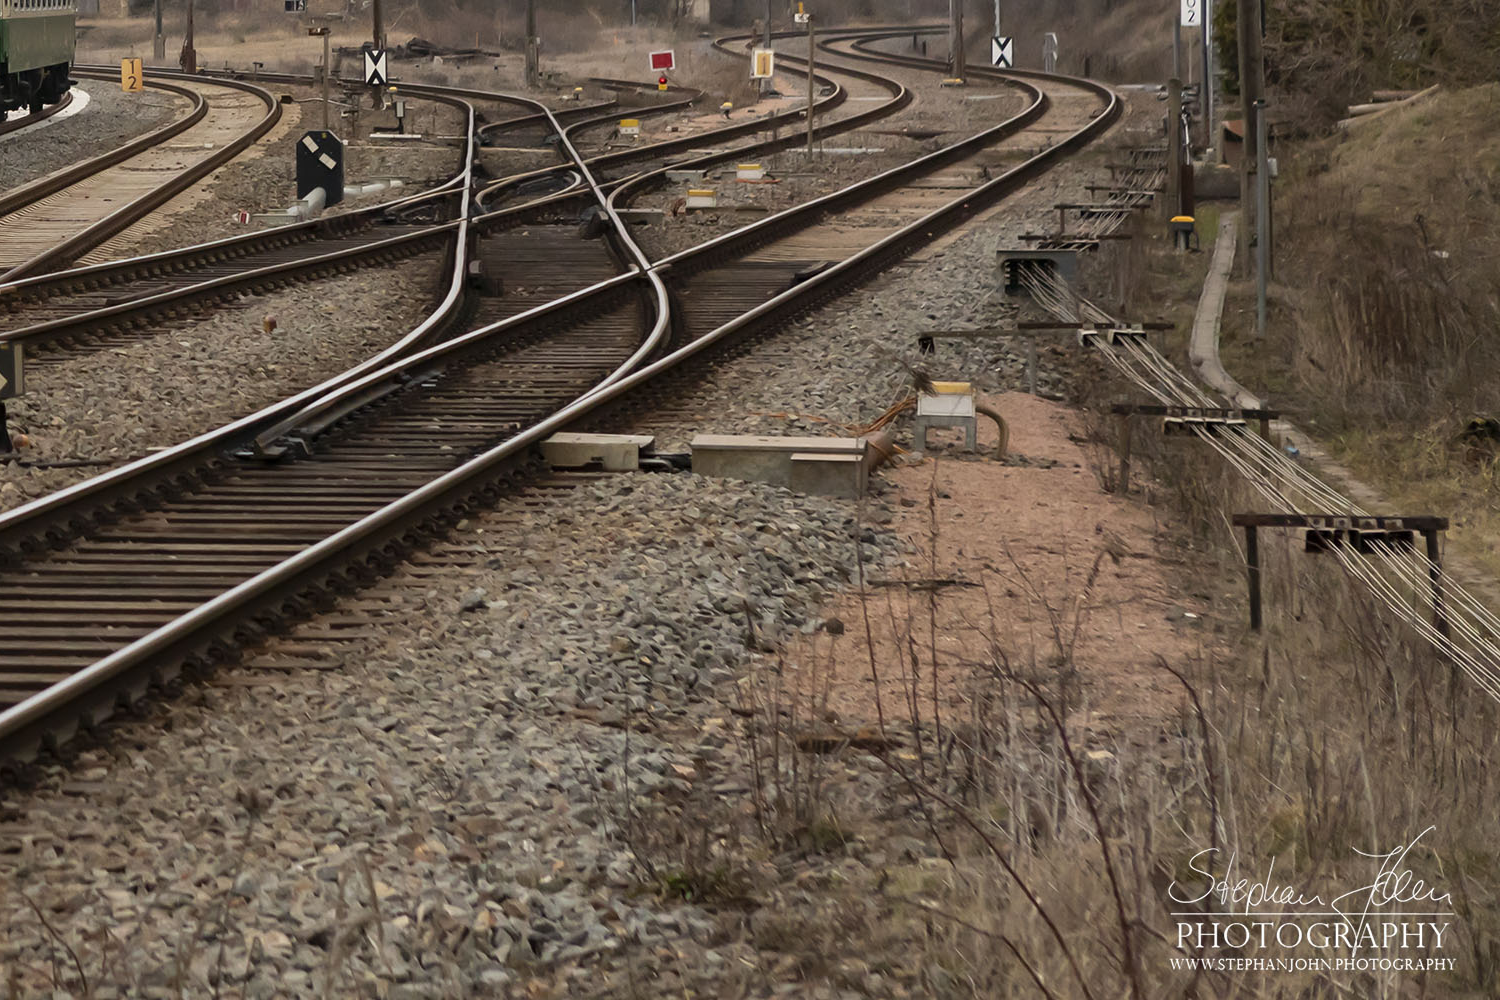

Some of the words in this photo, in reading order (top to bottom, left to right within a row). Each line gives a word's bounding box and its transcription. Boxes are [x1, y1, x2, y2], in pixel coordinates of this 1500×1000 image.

[1187, 9, 1196, 23] 2
[129, 59, 135, 74] 1
[127, 75, 138, 90] 2
